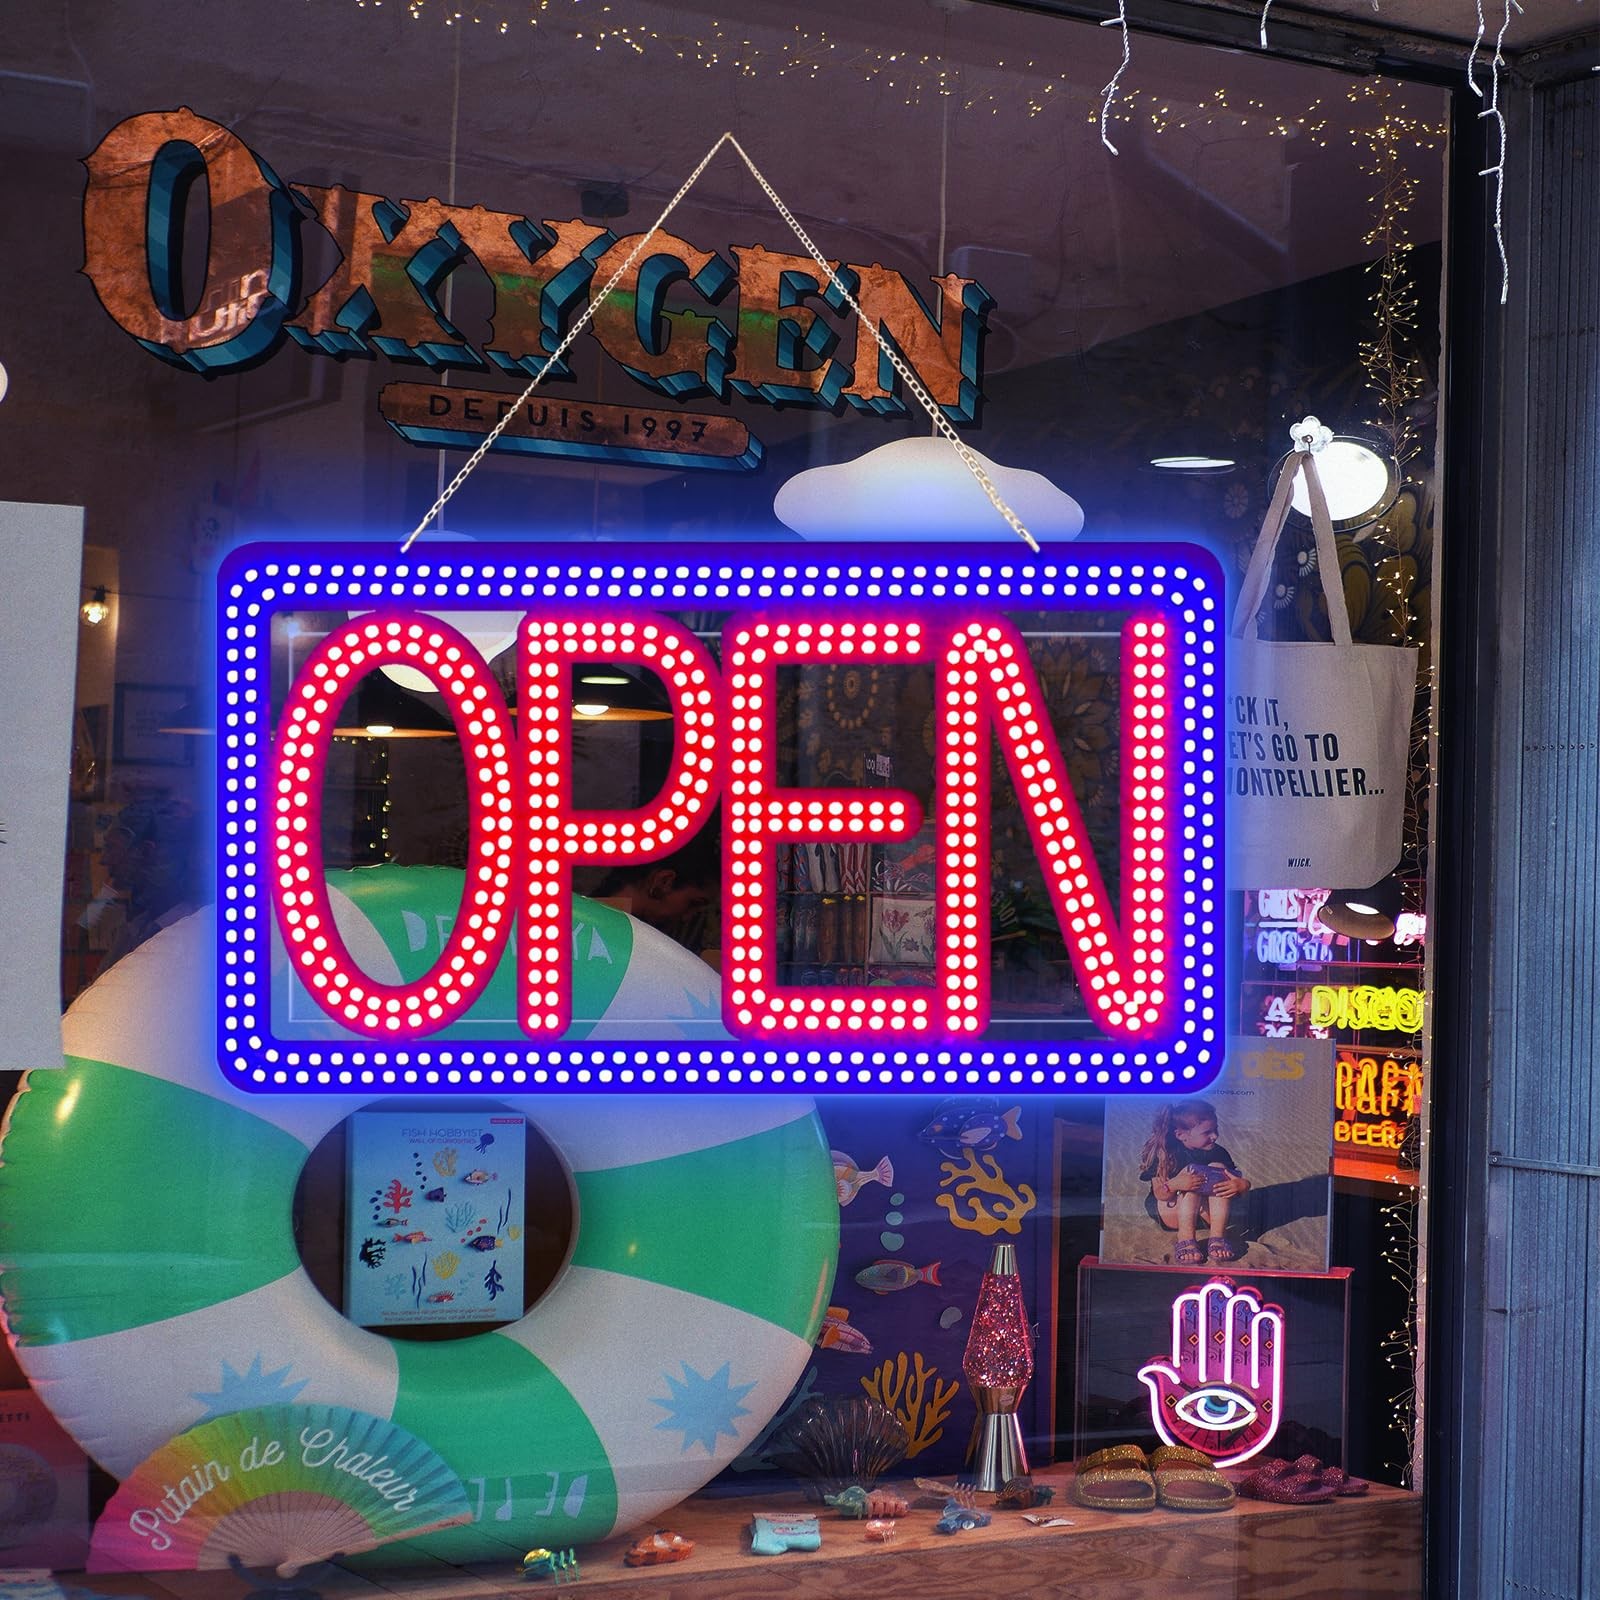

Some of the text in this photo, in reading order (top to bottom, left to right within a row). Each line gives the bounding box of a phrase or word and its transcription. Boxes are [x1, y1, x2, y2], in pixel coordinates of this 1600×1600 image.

[79, 106, 997, 428] OXYGEN
[429, 394, 709, 442] DEPUIS 1997
[1264, 698, 1289, 732] IT,
[1227, 731, 1339, 762] ET'S GO TO
[274, 608, 1182, 1036] OPEN
[401, 1128, 484, 1138] FISH HOBBYIST
[129, 1426, 417, 1551] Putain de Chaleur
